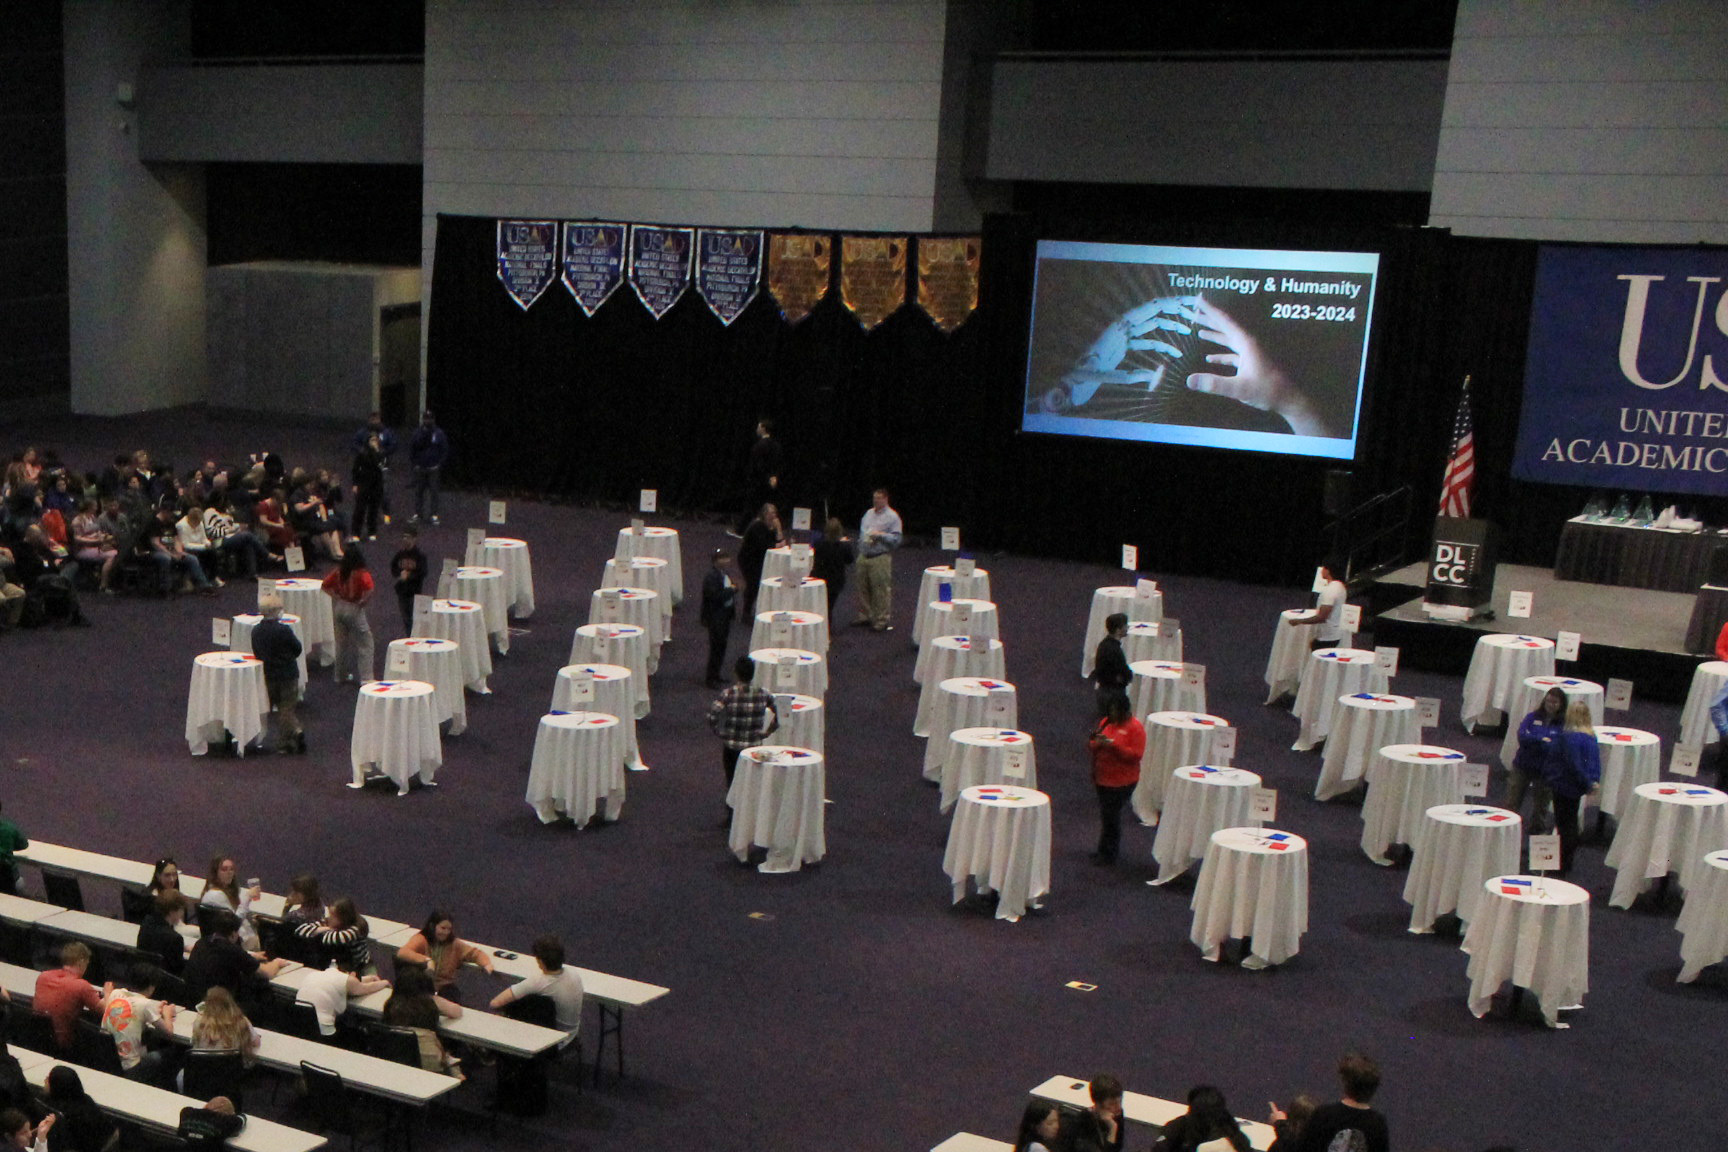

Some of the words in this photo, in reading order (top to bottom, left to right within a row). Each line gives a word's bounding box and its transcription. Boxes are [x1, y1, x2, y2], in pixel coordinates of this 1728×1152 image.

[1168, 272, 1260, 294] Technology
[1264, 276, 1276, 292] &
[1281, 277, 1362, 299] Humanity
[1271, 303, 1356, 322] 2023-2024
[1619, 407, 1728, 439] UNITE
[1541, 437, 1728, 473] ACADEMIC
[1436, 544, 1466, 565] DL
[1433, 563, 1466, 584] CC
